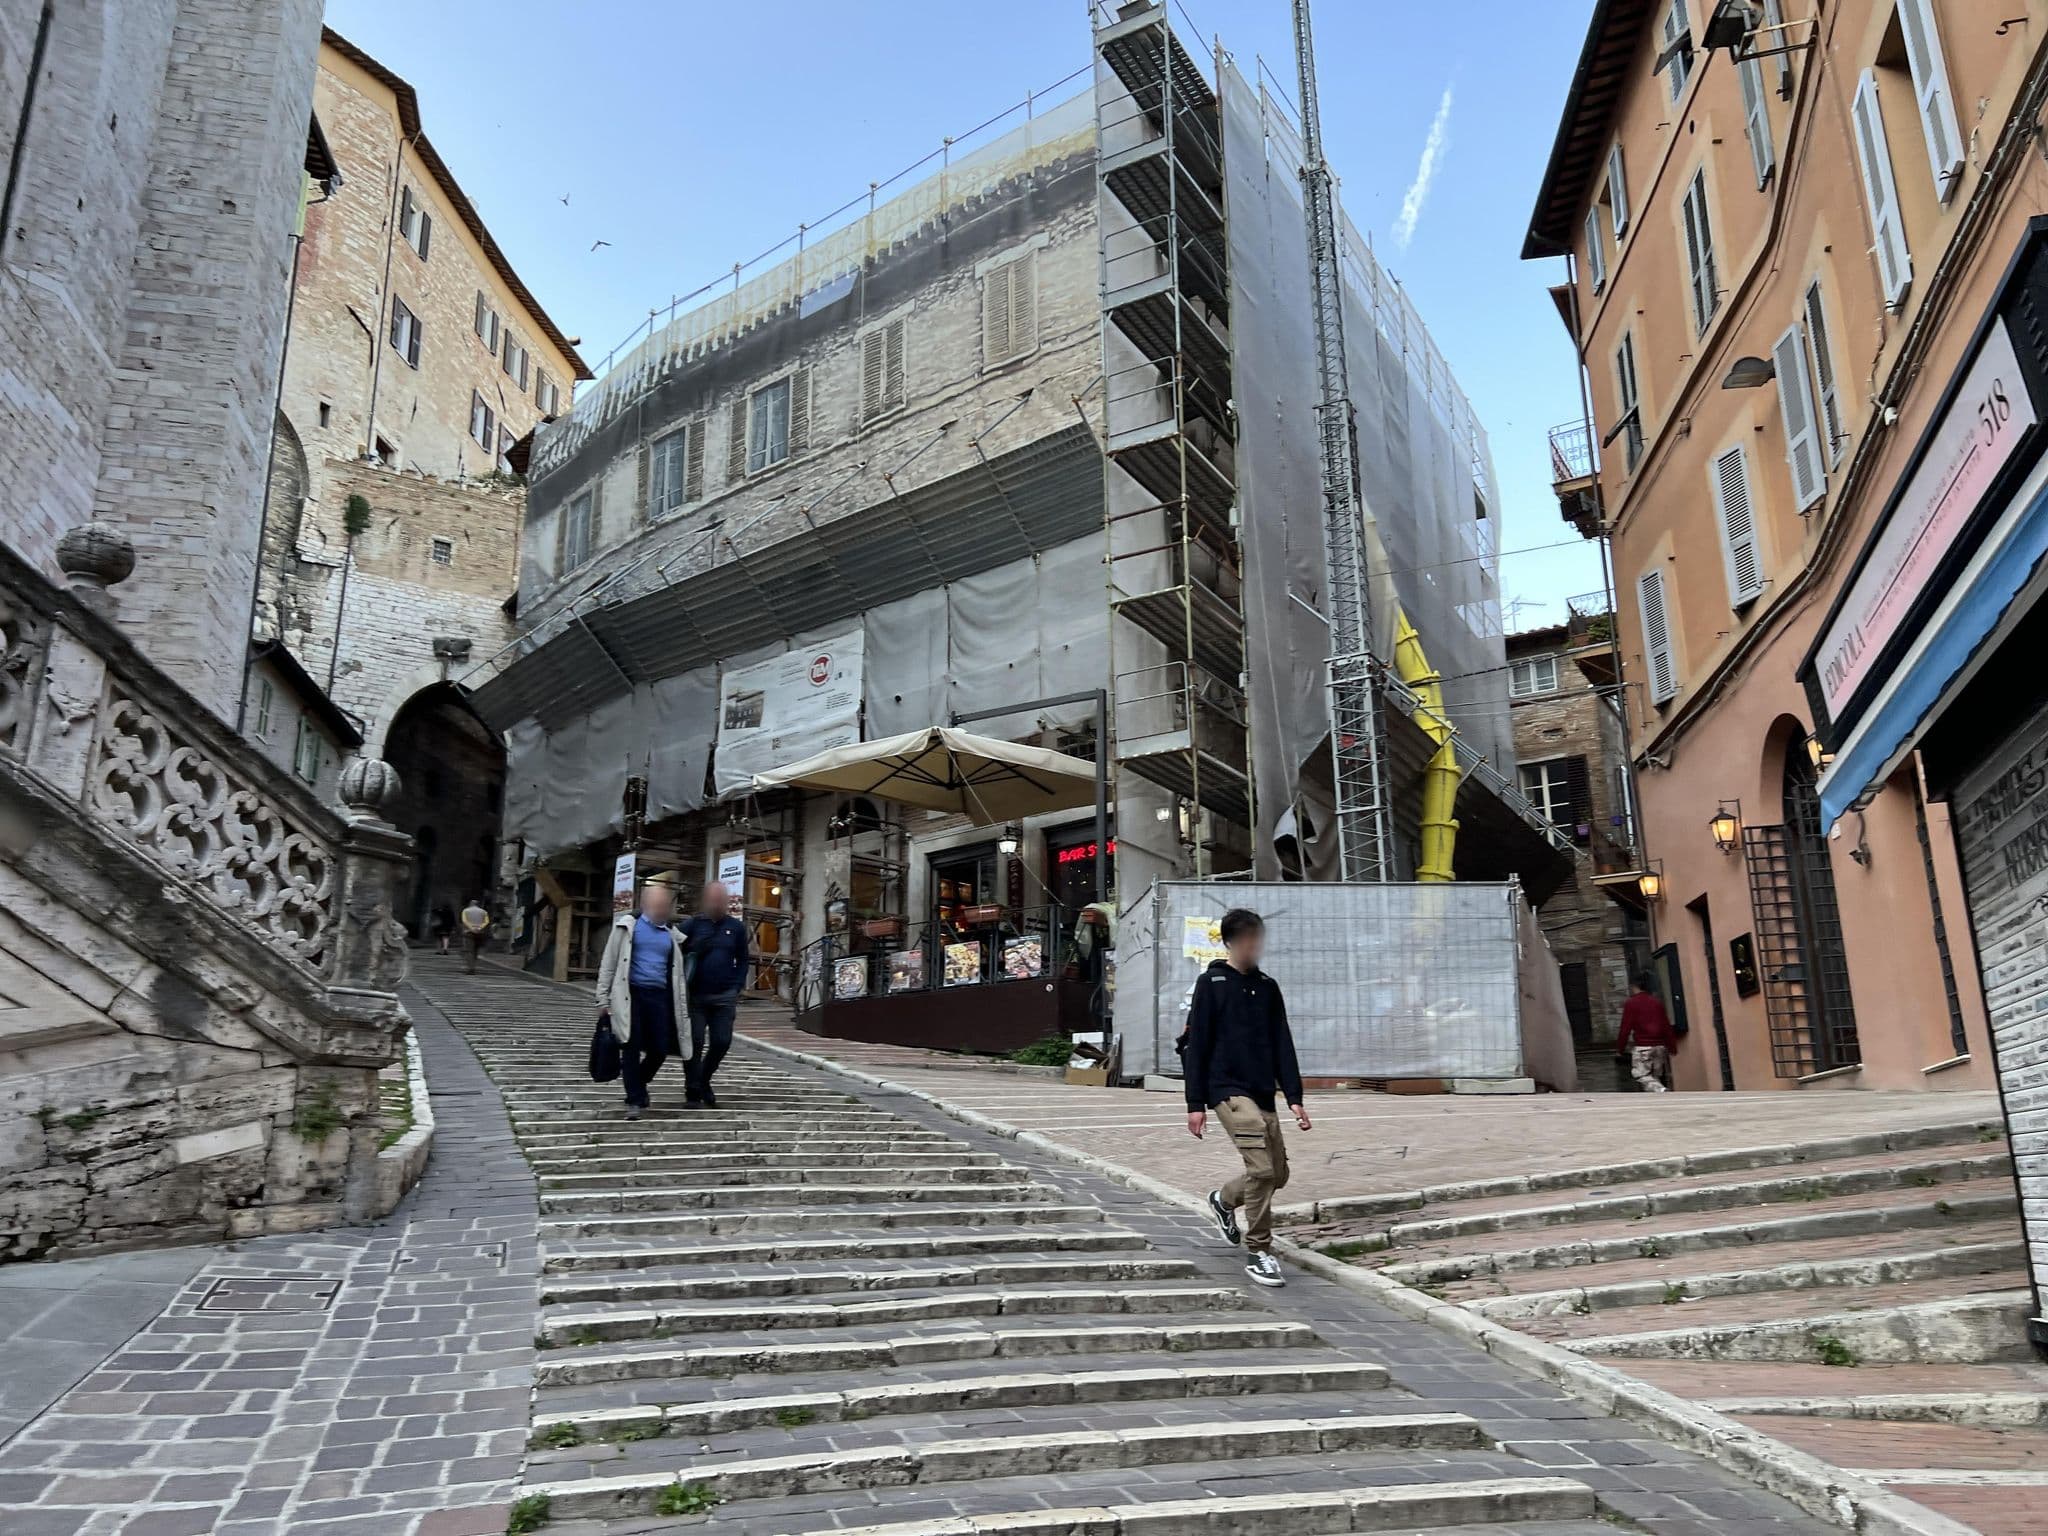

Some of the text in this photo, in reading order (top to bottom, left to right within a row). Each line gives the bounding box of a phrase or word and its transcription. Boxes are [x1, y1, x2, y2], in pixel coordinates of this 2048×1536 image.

[1824, 378, 2010, 699] EDICOLA 518
[1059, 847, 1086, 863] BAR
